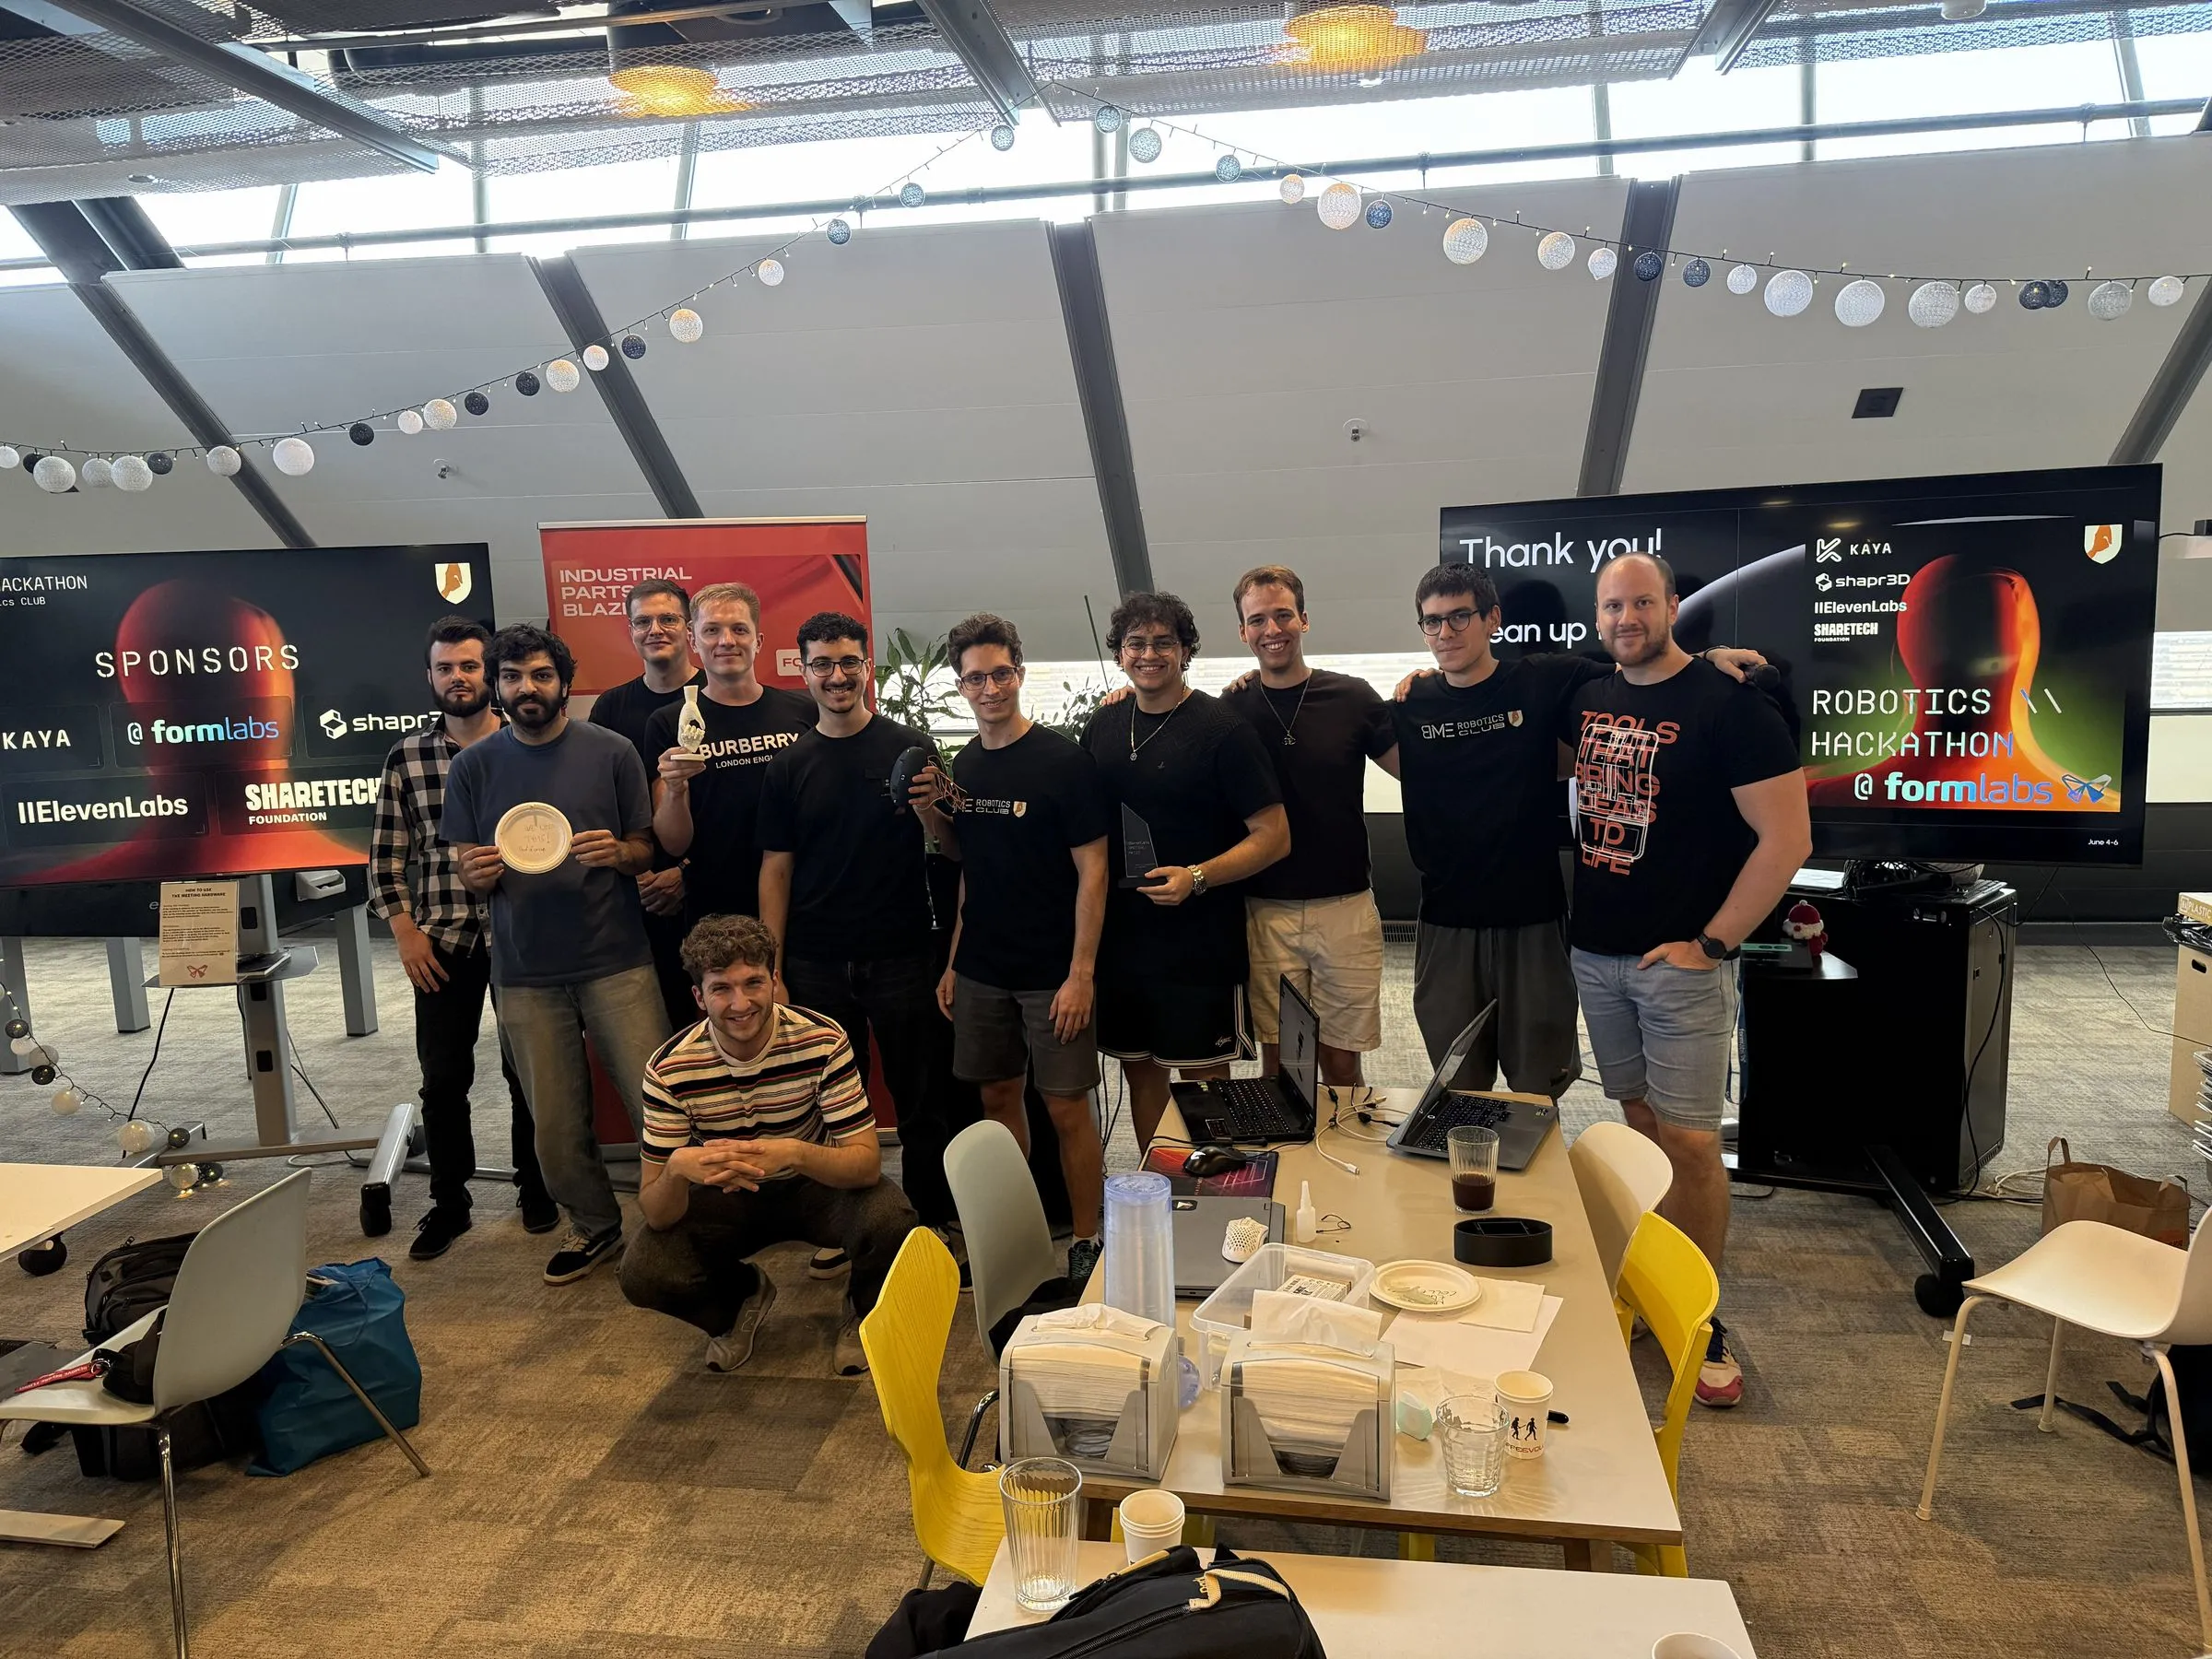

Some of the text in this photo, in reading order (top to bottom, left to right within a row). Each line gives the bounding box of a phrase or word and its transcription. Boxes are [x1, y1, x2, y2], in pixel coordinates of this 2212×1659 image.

[1459, 532, 1574, 569] Thank
[1850, 542, 1892, 556] KAYA
[559, 567, 693, 583] INDUSTRIAL
[1835, 573, 1911, 588] shapr3D
[20, 595, 46, 606] CLUB
[561, 584, 635, 600] PARTS
[1549, 622, 1587, 650] up
[1814, 622, 1879, 636] SHARETECH
[95, 644, 300, 678] SPONSORS
[1812, 688, 1992, 715] ROBOTICS
[127, 715, 280, 745] @ formlabs
[1456, 713, 1505, 730] ROBOTICS
[1458, 722, 1506, 736] CLUB
[1580, 711, 1681, 745] TOOLS
[2, 729, 72, 750] KAYA
[699, 732, 799, 760] BURBERRY
[1811, 731, 2014, 758] HACKATHON
[715, 758, 751, 769] LONDON
[244, 777, 382, 811] SHARETECH
[1853, 771, 2054, 804] @ formlabs
[975, 798, 1011, 808] ROBOTICS
[975, 806, 1009, 815] CLUB
[248, 811, 328, 825] FOUNDATION
[1589, 817, 1626, 846] TO
